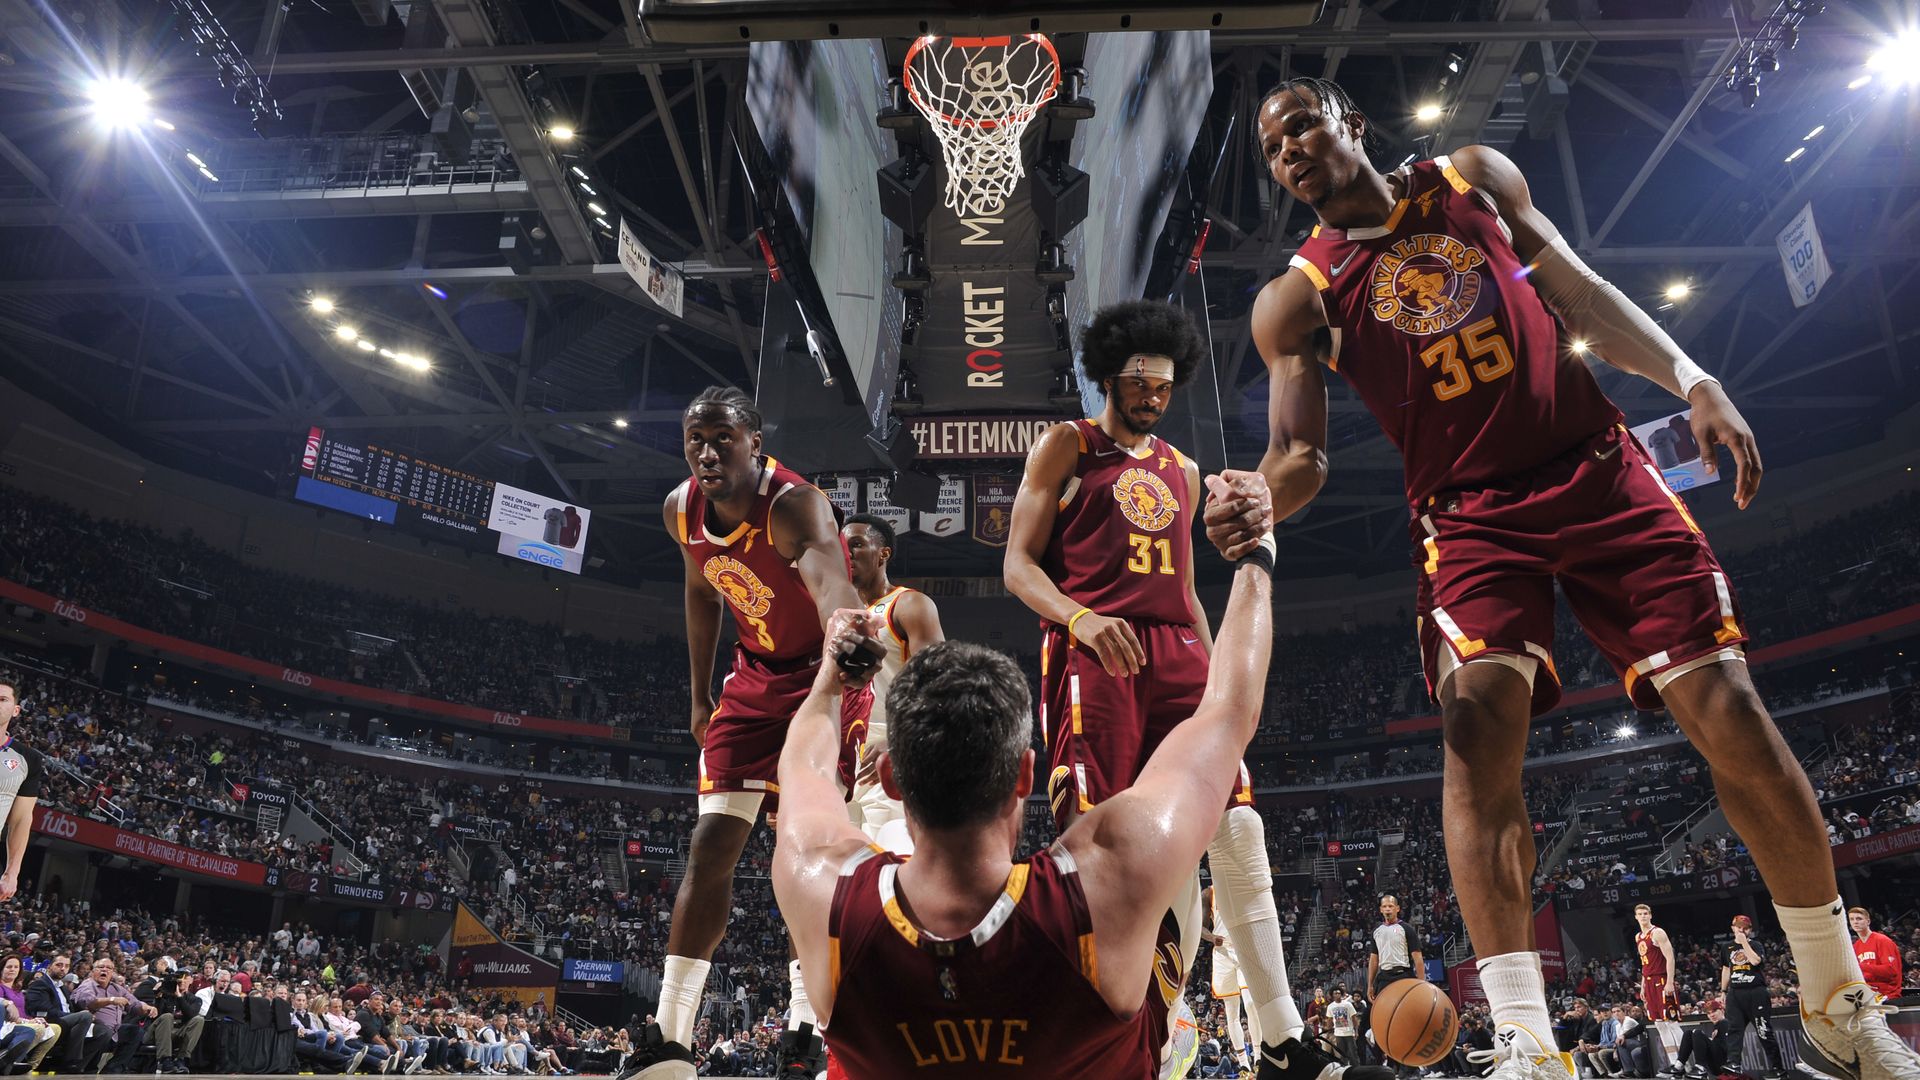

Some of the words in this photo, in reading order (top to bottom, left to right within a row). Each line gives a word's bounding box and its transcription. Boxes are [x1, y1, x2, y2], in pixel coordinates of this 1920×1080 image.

[1790, 240, 1812, 272] 100
[1368, 233, 1486, 322] CAVALIERS
[1390, 270, 1482, 336] CLEVELAND
[962, 282, 1004, 388] ROCKET
[1420, 315, 1514, 402] 35
[911, 421, 1063, 454] #LETEMKNO
[1113, 468, 1180, 512] CAVALIERS
[501, 500, 532, 513] COLLECTION
[502, 494, 514, 502] NIKE
[524, 500, 540, 509] COURT
[870, 508, 906, 516] CHAMPIONS
[1120, 501, 1175, 531] CLEVELAND
[422, 513, 445, 524] DANILO
[446, 520, 478, 533] GALLINARI
[1128, 533, 1176, 575] 31
[52, 600, 86, 623] fubo
[745, 615, 775, 652] 3
[282, 668, 312, 687] fubo
[492, 711, 522, 727] fubo
[252, 791, 286, 804] TOYOTA
[454, 826, 475, 834] TOYOTA
[1545, 821, 1567, 829] TOYOTA
[40, 811, 78, 838] fubo
[116, 833, 145, 854] OFFICIAL
[147, 841, 176, 863] PARTNER
[176, 850, 186, 864] OF
[187, 853, 200, 868] THE
[200, 856, 239, 876] CAVALIERS
[1621, 831, 1648, 841] Homes
[644, 845, 674, 855] TOYOTA
[1343, 842, 1376, 851] TOYOTA
[1856, 839, 1888, 858] OFFICIAL
[1598, 853, 1621, 862] Homes
[266, 874, 278, 886] 48
[1702, 874, 1719, 889] 29
[1751, 871, 1758, 881] 2
[309, 878, 318, 892] 2
[334, 883, 384, 900] TURNOVERS
[1630, 888, 1640, 896] 20
[1649, 885, 1672, 896] 8:20
[1682, 881, 1692, 889] 19
[400, 892, 408, 905] 7
[1602, 889, 1619, 904] 39
[441, 902, 452, 912] 44
[575, 960, 612, 972] SHERWIN
[1417, 1007, 1451, 1059] Wilson
[897, 1018, 1029, 1067] LOVE
